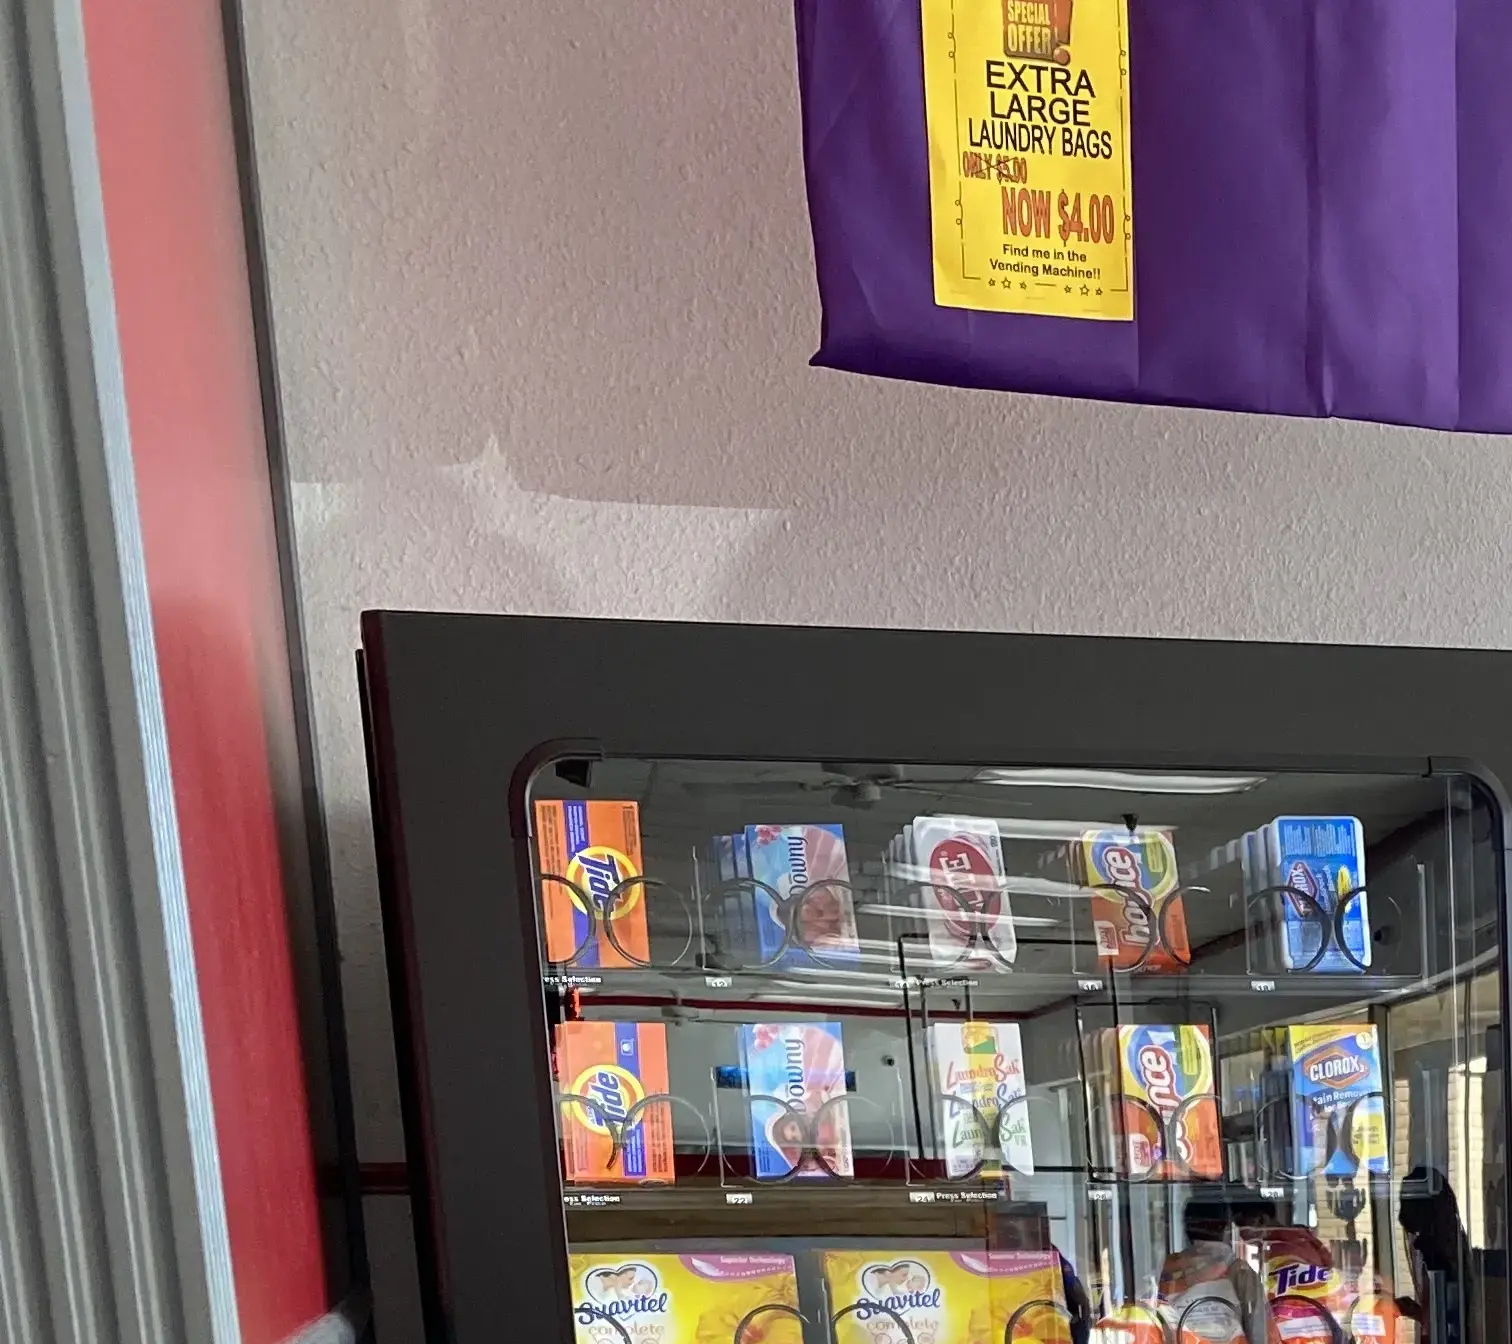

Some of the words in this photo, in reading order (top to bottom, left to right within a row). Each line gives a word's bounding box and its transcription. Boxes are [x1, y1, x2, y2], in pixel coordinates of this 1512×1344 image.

[1007, 0, 1051, 25] SPECIAL
[986, 60, 1096, 98] EXTRA
[990, 91, 1091, 127] LARGE
[968, 117, 1056, 155] LAUNDRY
[1062, 127, 1113, 160] BAGS
[1001, 186, 1051, 239] NOW
[1058, 188, 1115, 247] $4.00
[990, 258, 1039, 277] Vending
[1042, 264, 1101, 280] Machine!!
[1003, 244, 1029, 258] Find
[1032, 247, 1051, 260] me
[1054, 249, 1065, 261] in
[1068, 250, 1087, 263] the
[1269, 1264, 1332, 1296] Tide
[577, 1292, 668, 1325] Suavitel
[856, 1287, 941, 1321] Suavitel
